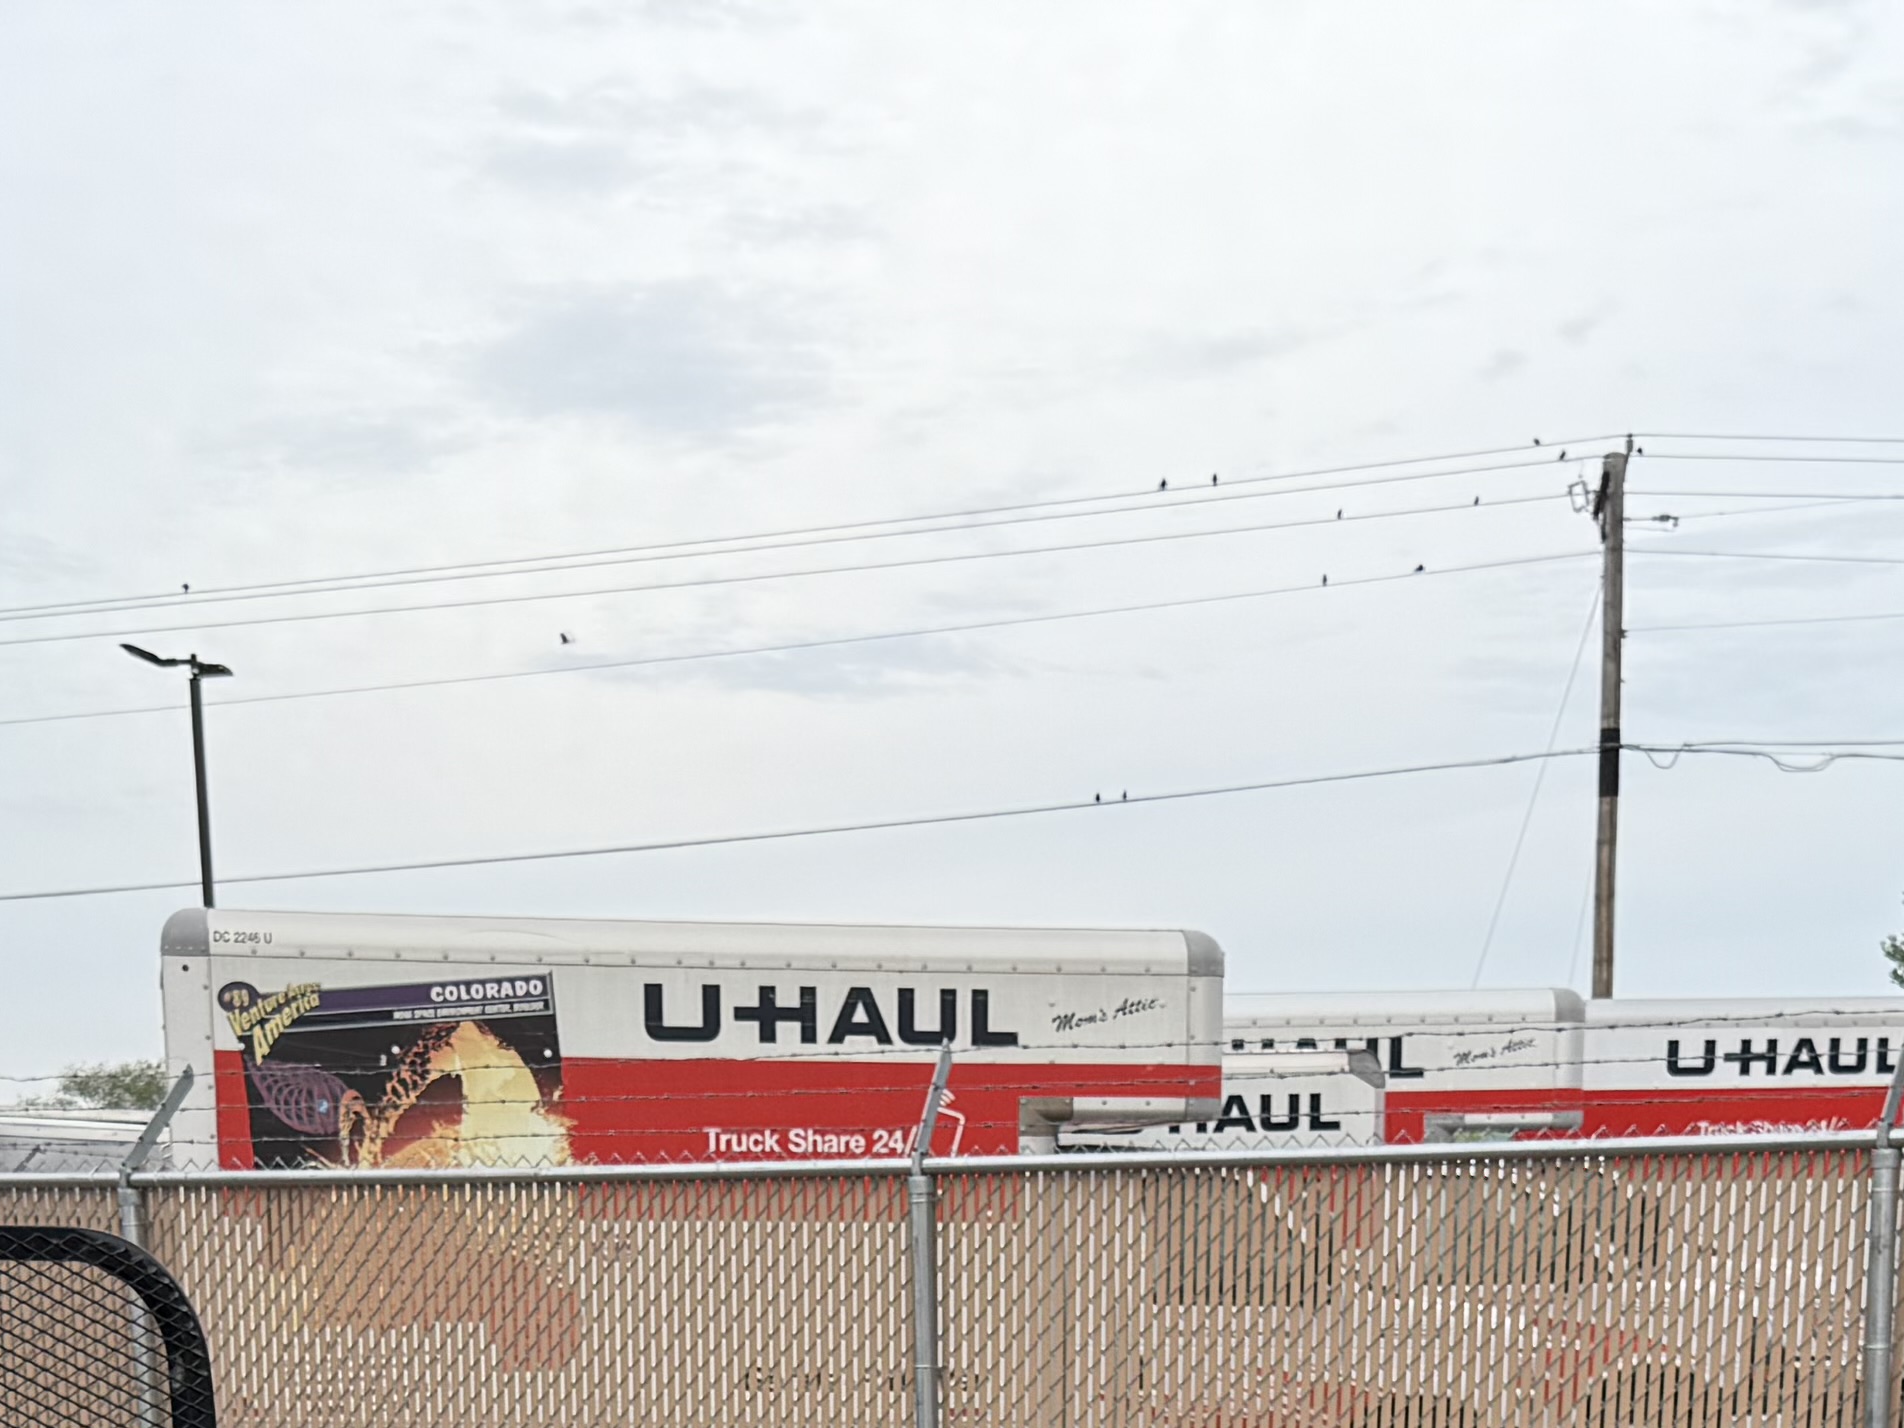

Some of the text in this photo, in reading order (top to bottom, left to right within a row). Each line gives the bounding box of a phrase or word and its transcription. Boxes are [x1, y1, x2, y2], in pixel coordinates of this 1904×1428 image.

[430, 980, 543, 1002] COLORADO
[253, 993, 321, 1066] America
[644, 983, 1019, 1047] U-HAUL
[1666, 1037, 1896, 1076] U-HAUL
[702, 1127, 918, 1158] Truck Share 24/
